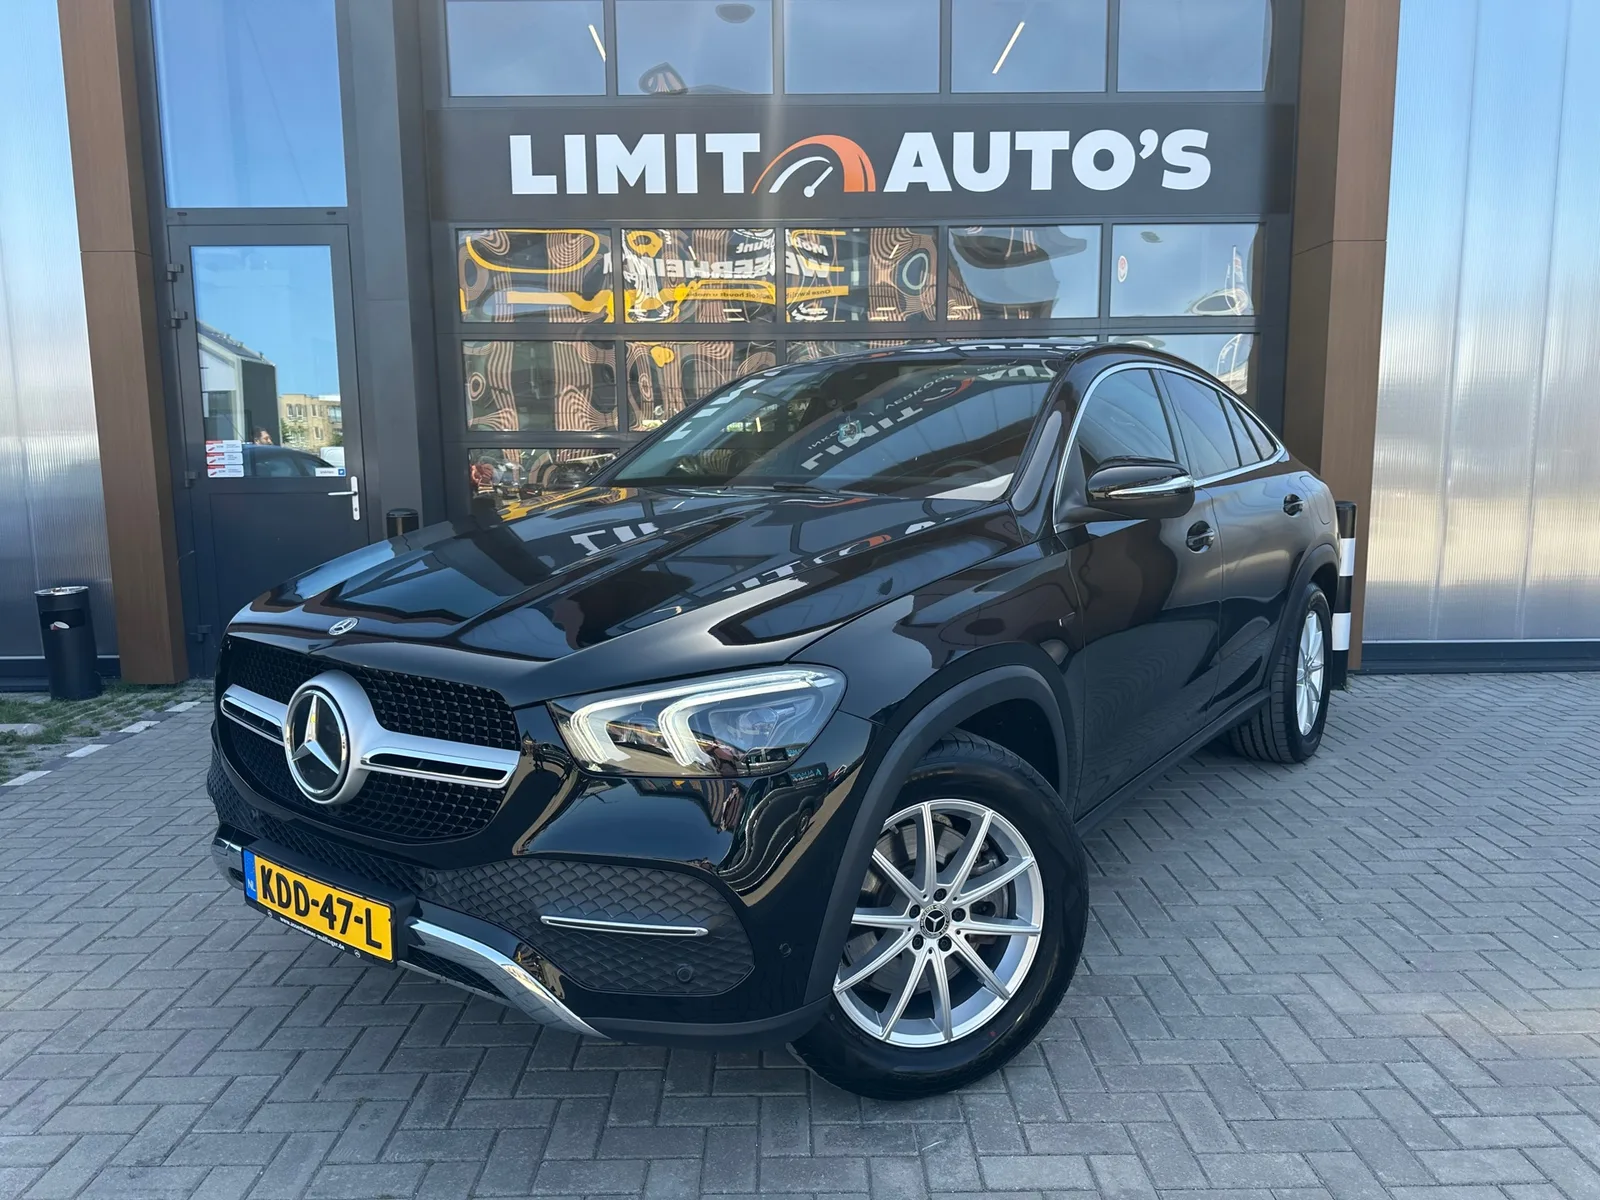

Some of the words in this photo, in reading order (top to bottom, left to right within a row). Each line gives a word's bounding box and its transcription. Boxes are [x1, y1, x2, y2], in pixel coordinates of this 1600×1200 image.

[510, 132, 760, 195] LIMIT
[883, 128, 1212, 194] AUTO'S
[247, 878, 257, 893] NL
[260, 864, 383, 950] KDD-47-L
